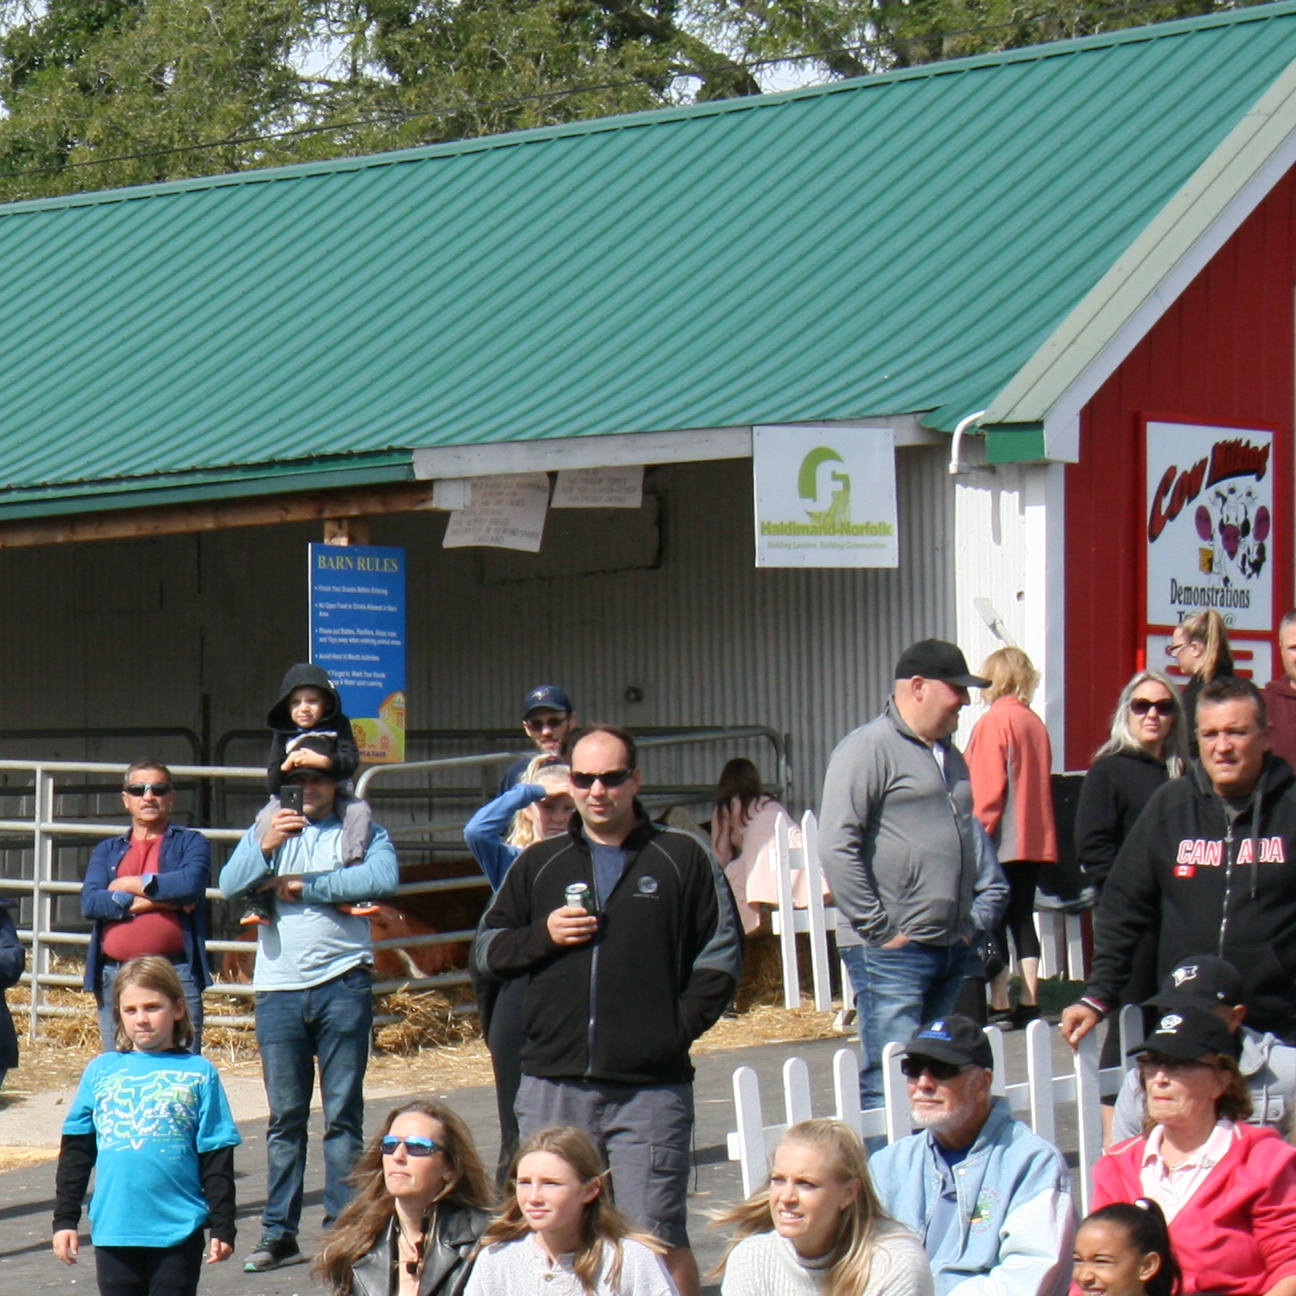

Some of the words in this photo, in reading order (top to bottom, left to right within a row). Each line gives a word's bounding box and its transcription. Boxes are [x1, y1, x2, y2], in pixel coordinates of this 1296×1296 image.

[1147, 455, 1208, 543] Cow
[1205, 437, 1271, 490] Milking
[761, 520, 892, 536] Haldimand-Norfolk
[318, 554, 353, 570] BARN
[357, 556, 398, 572] RULES
[1169, 577, 1250, 609] Demonstrations
[1176, 836, 1285, 867] CANADA
